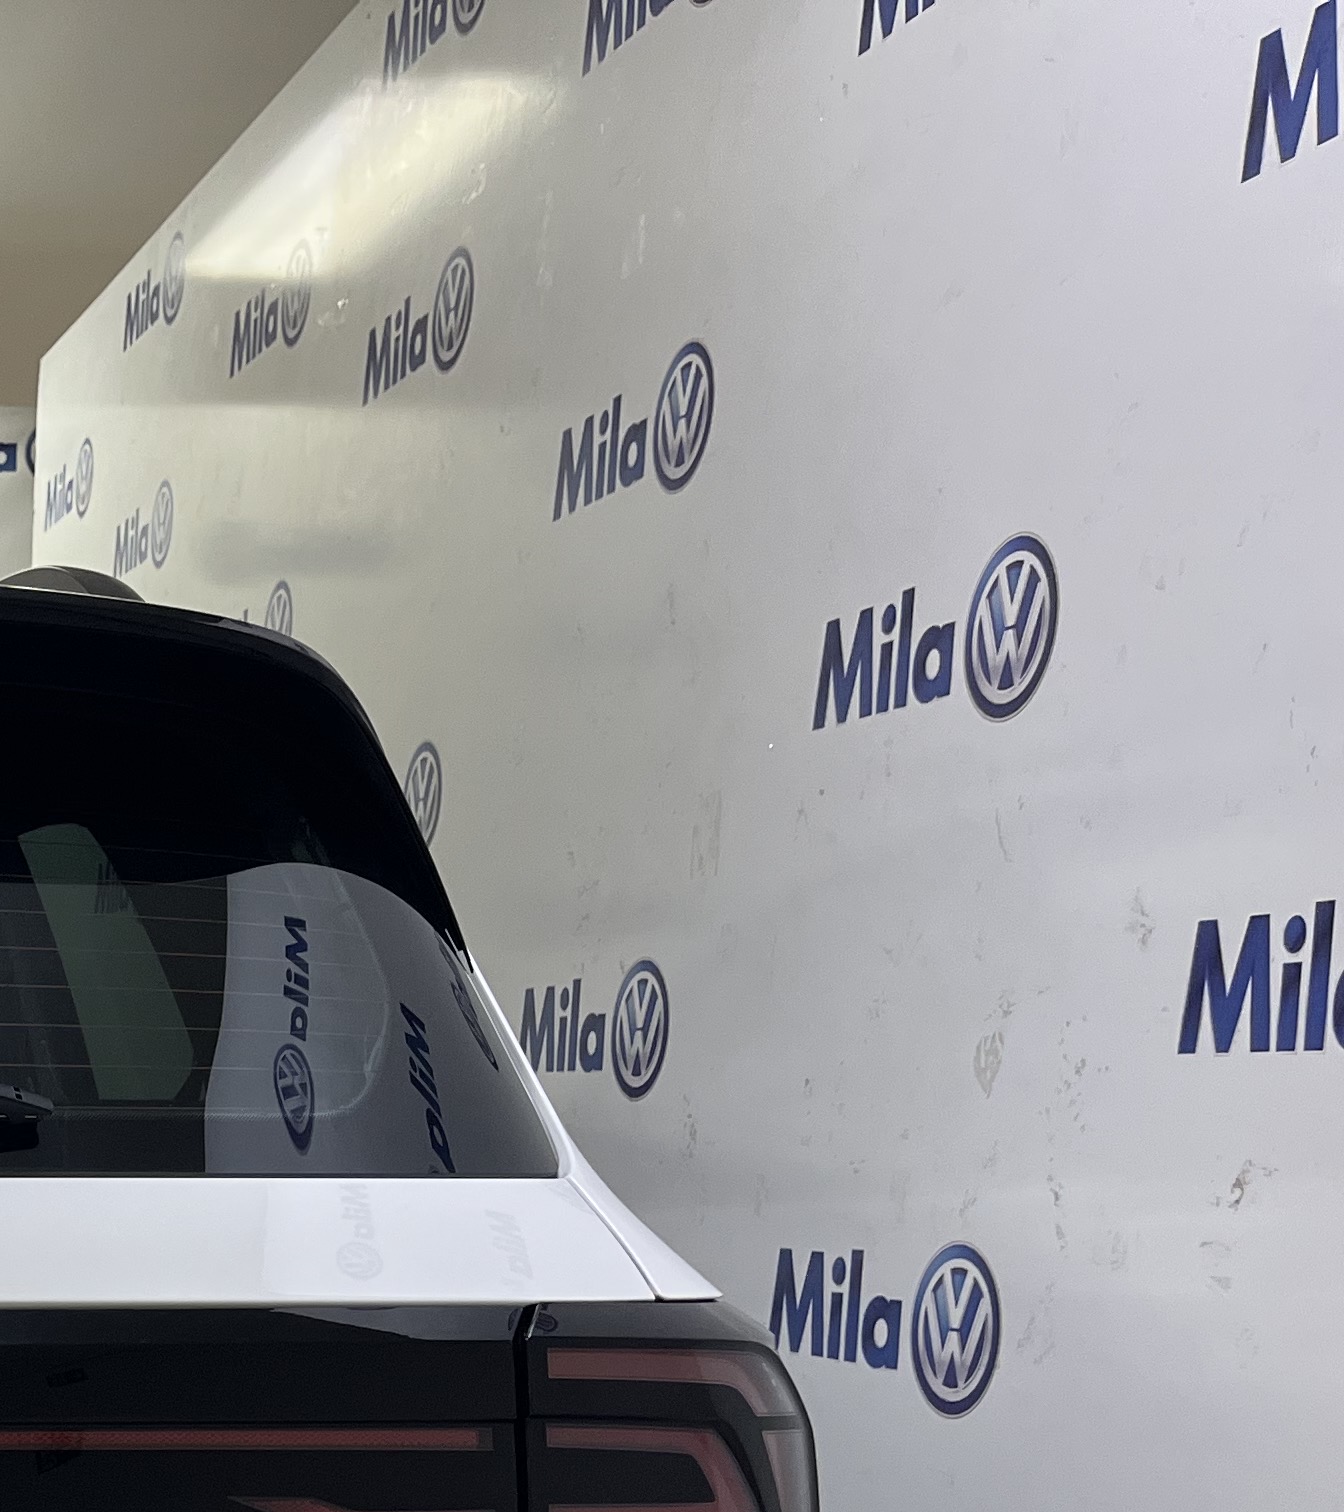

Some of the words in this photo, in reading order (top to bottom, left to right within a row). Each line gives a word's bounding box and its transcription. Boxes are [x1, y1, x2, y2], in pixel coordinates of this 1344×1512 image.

[123, 270, 161, 352] Mila
[229, 288, 279, 378] Mila
[362, 296, 429, 406] Mila
[553, 394, 648, 522] Mila
[654, 342, 714, 491] VW
[45, 454, 74, 532] Mila
[114, 507, 149, 578] Mila
[813, 587, 956, 741] Mila
[966, 535, 1058, 719] VW
[520, 979, 606, 1072] Mila
[612, 960, 669, 1098] VW
[769, 1248, 903, 1370] Mila
[912, 1243, 999, 1415] VW
